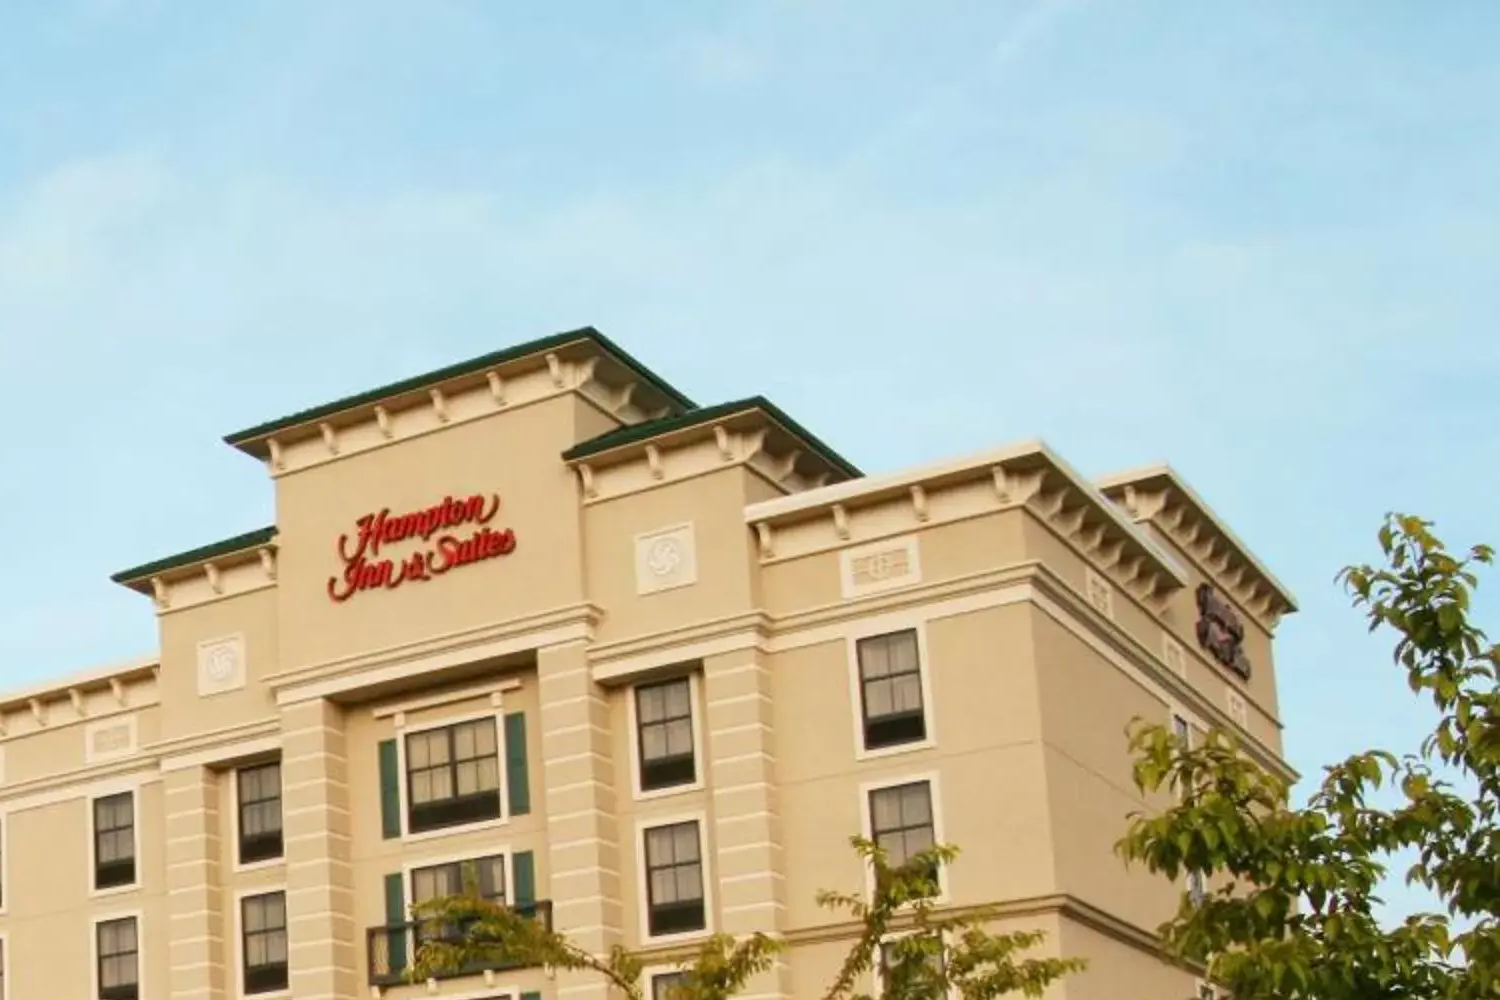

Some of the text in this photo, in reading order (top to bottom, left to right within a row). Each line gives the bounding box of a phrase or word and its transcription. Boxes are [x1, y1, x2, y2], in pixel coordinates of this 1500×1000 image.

[338, 494, 500, 562] Hampton
[327, 556, 404, 602] Inn
[426, 528, 516, 574] Suites
